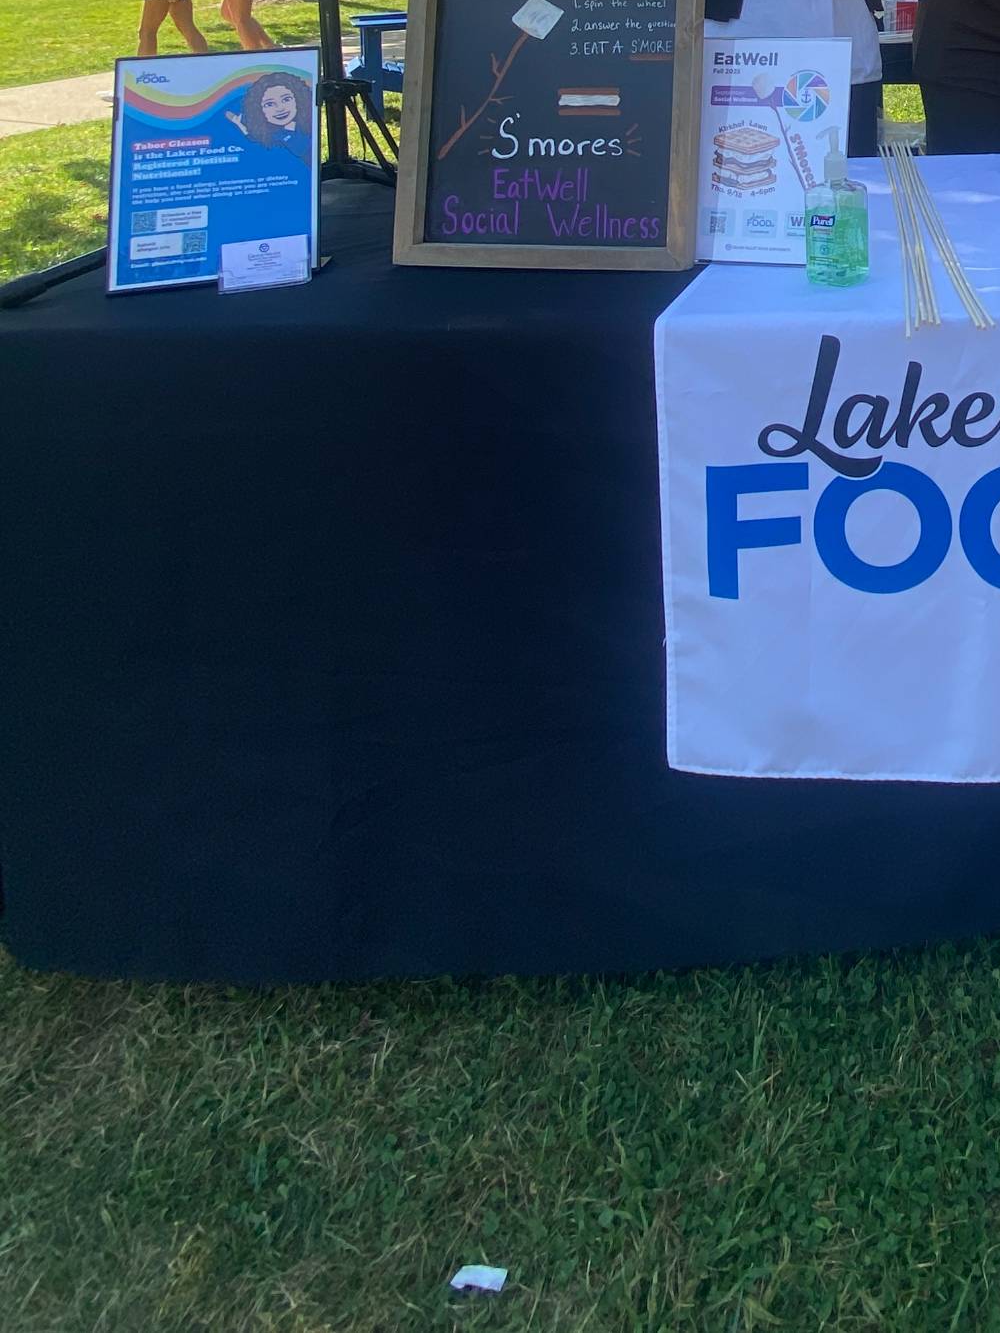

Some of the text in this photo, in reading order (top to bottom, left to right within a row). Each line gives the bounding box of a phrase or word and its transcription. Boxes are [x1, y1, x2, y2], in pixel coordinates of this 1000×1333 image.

[636, 0, 666, 8] wheel
[571, 19, 581, 31] 2.
[584, 21, 620, 31] answer
[625, 18, 642, 28] the
[570, 39, 673, 55] 3. EAT A S'MORE
[713, 52, 779, 66] EatWell
[136, 75, 166, 85] FOOD
[491, 113, 624, 159] S'mores
[134, 139, 210, 150] Tabor Gleason
[146, 151, 164, 159] the
[166, 149, 197, 158] Laker
[199, 146, 226, 155] Food
[227, 145, 245, 153] Co.
[133, 155, 239, 171] Registered Dietitian
[132, 167, 202, 181] Nutritionist!
[442, 195, 661, 239] Social Wellness
[746, 219, 772, 227] FOOD
[812, 216, 834, 225] Purell
